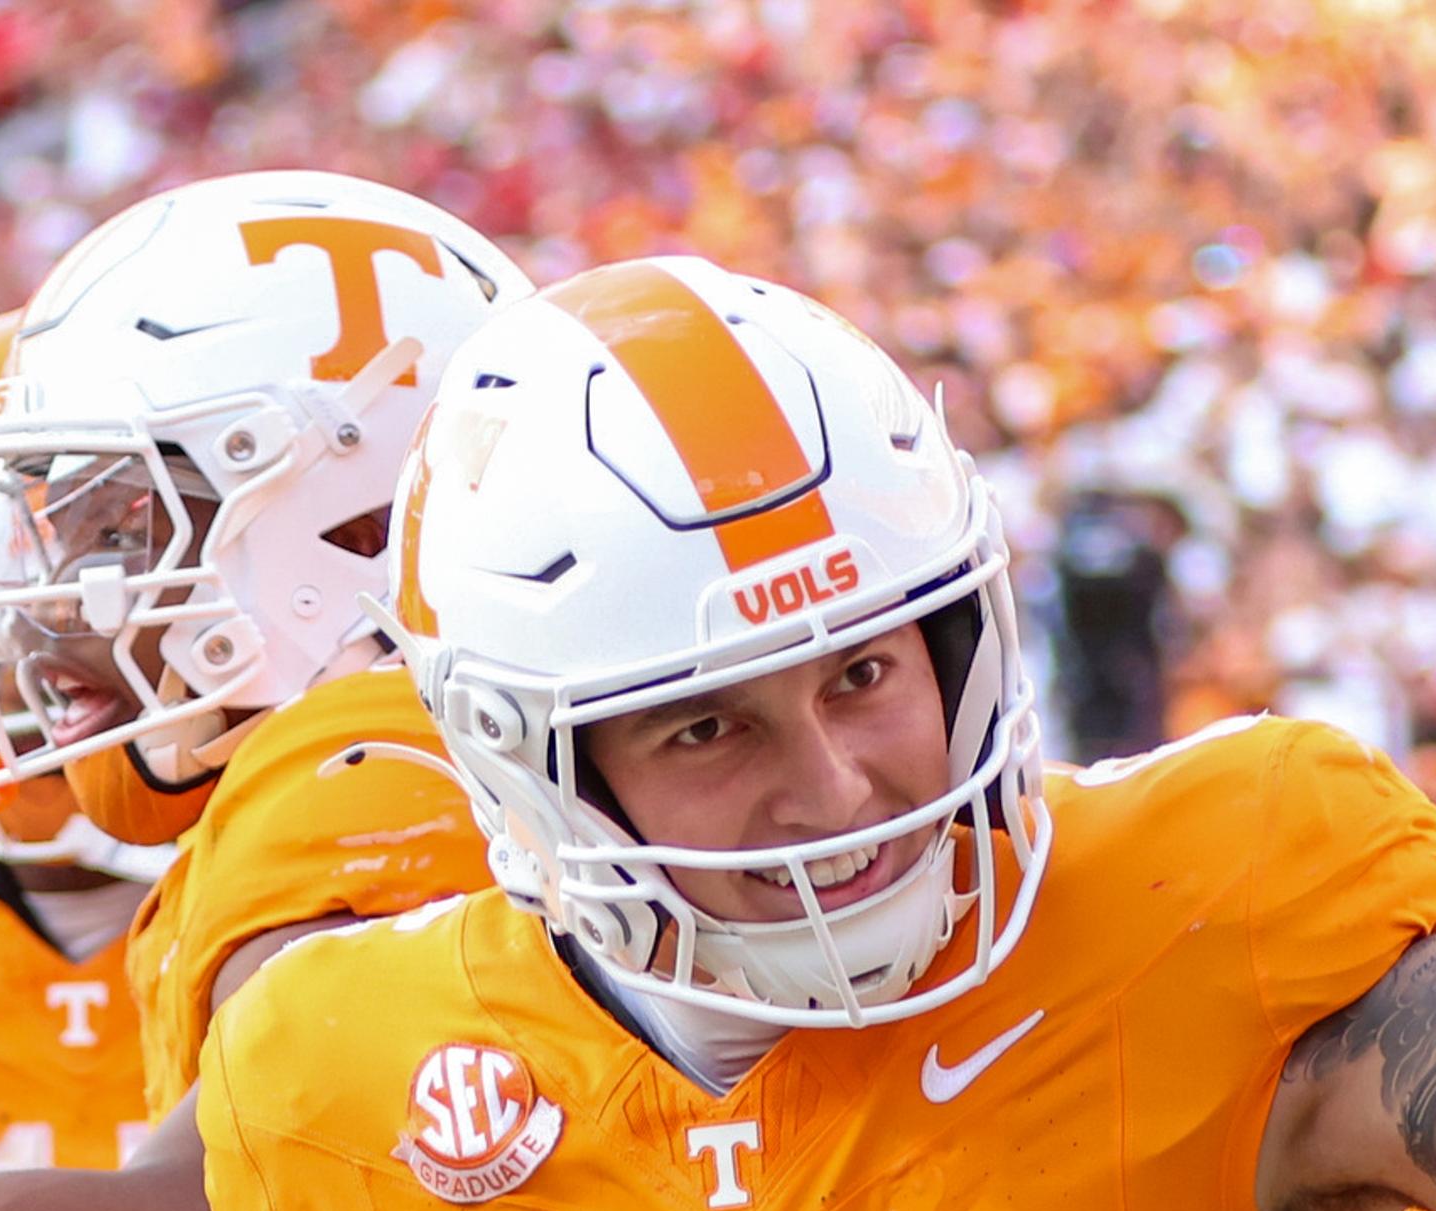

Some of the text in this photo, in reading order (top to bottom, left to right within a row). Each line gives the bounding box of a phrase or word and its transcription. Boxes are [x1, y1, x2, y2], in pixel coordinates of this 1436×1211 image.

[238, 216, 445, 387] T
[733, 550, 859, 625] VOLS
[45, 981, 110, 1046] T
[415, 1046, 521, 1159] SEC
[420, 1133, 547, 1198] GRADUATE
[685, 1119, 762, 1211] T
